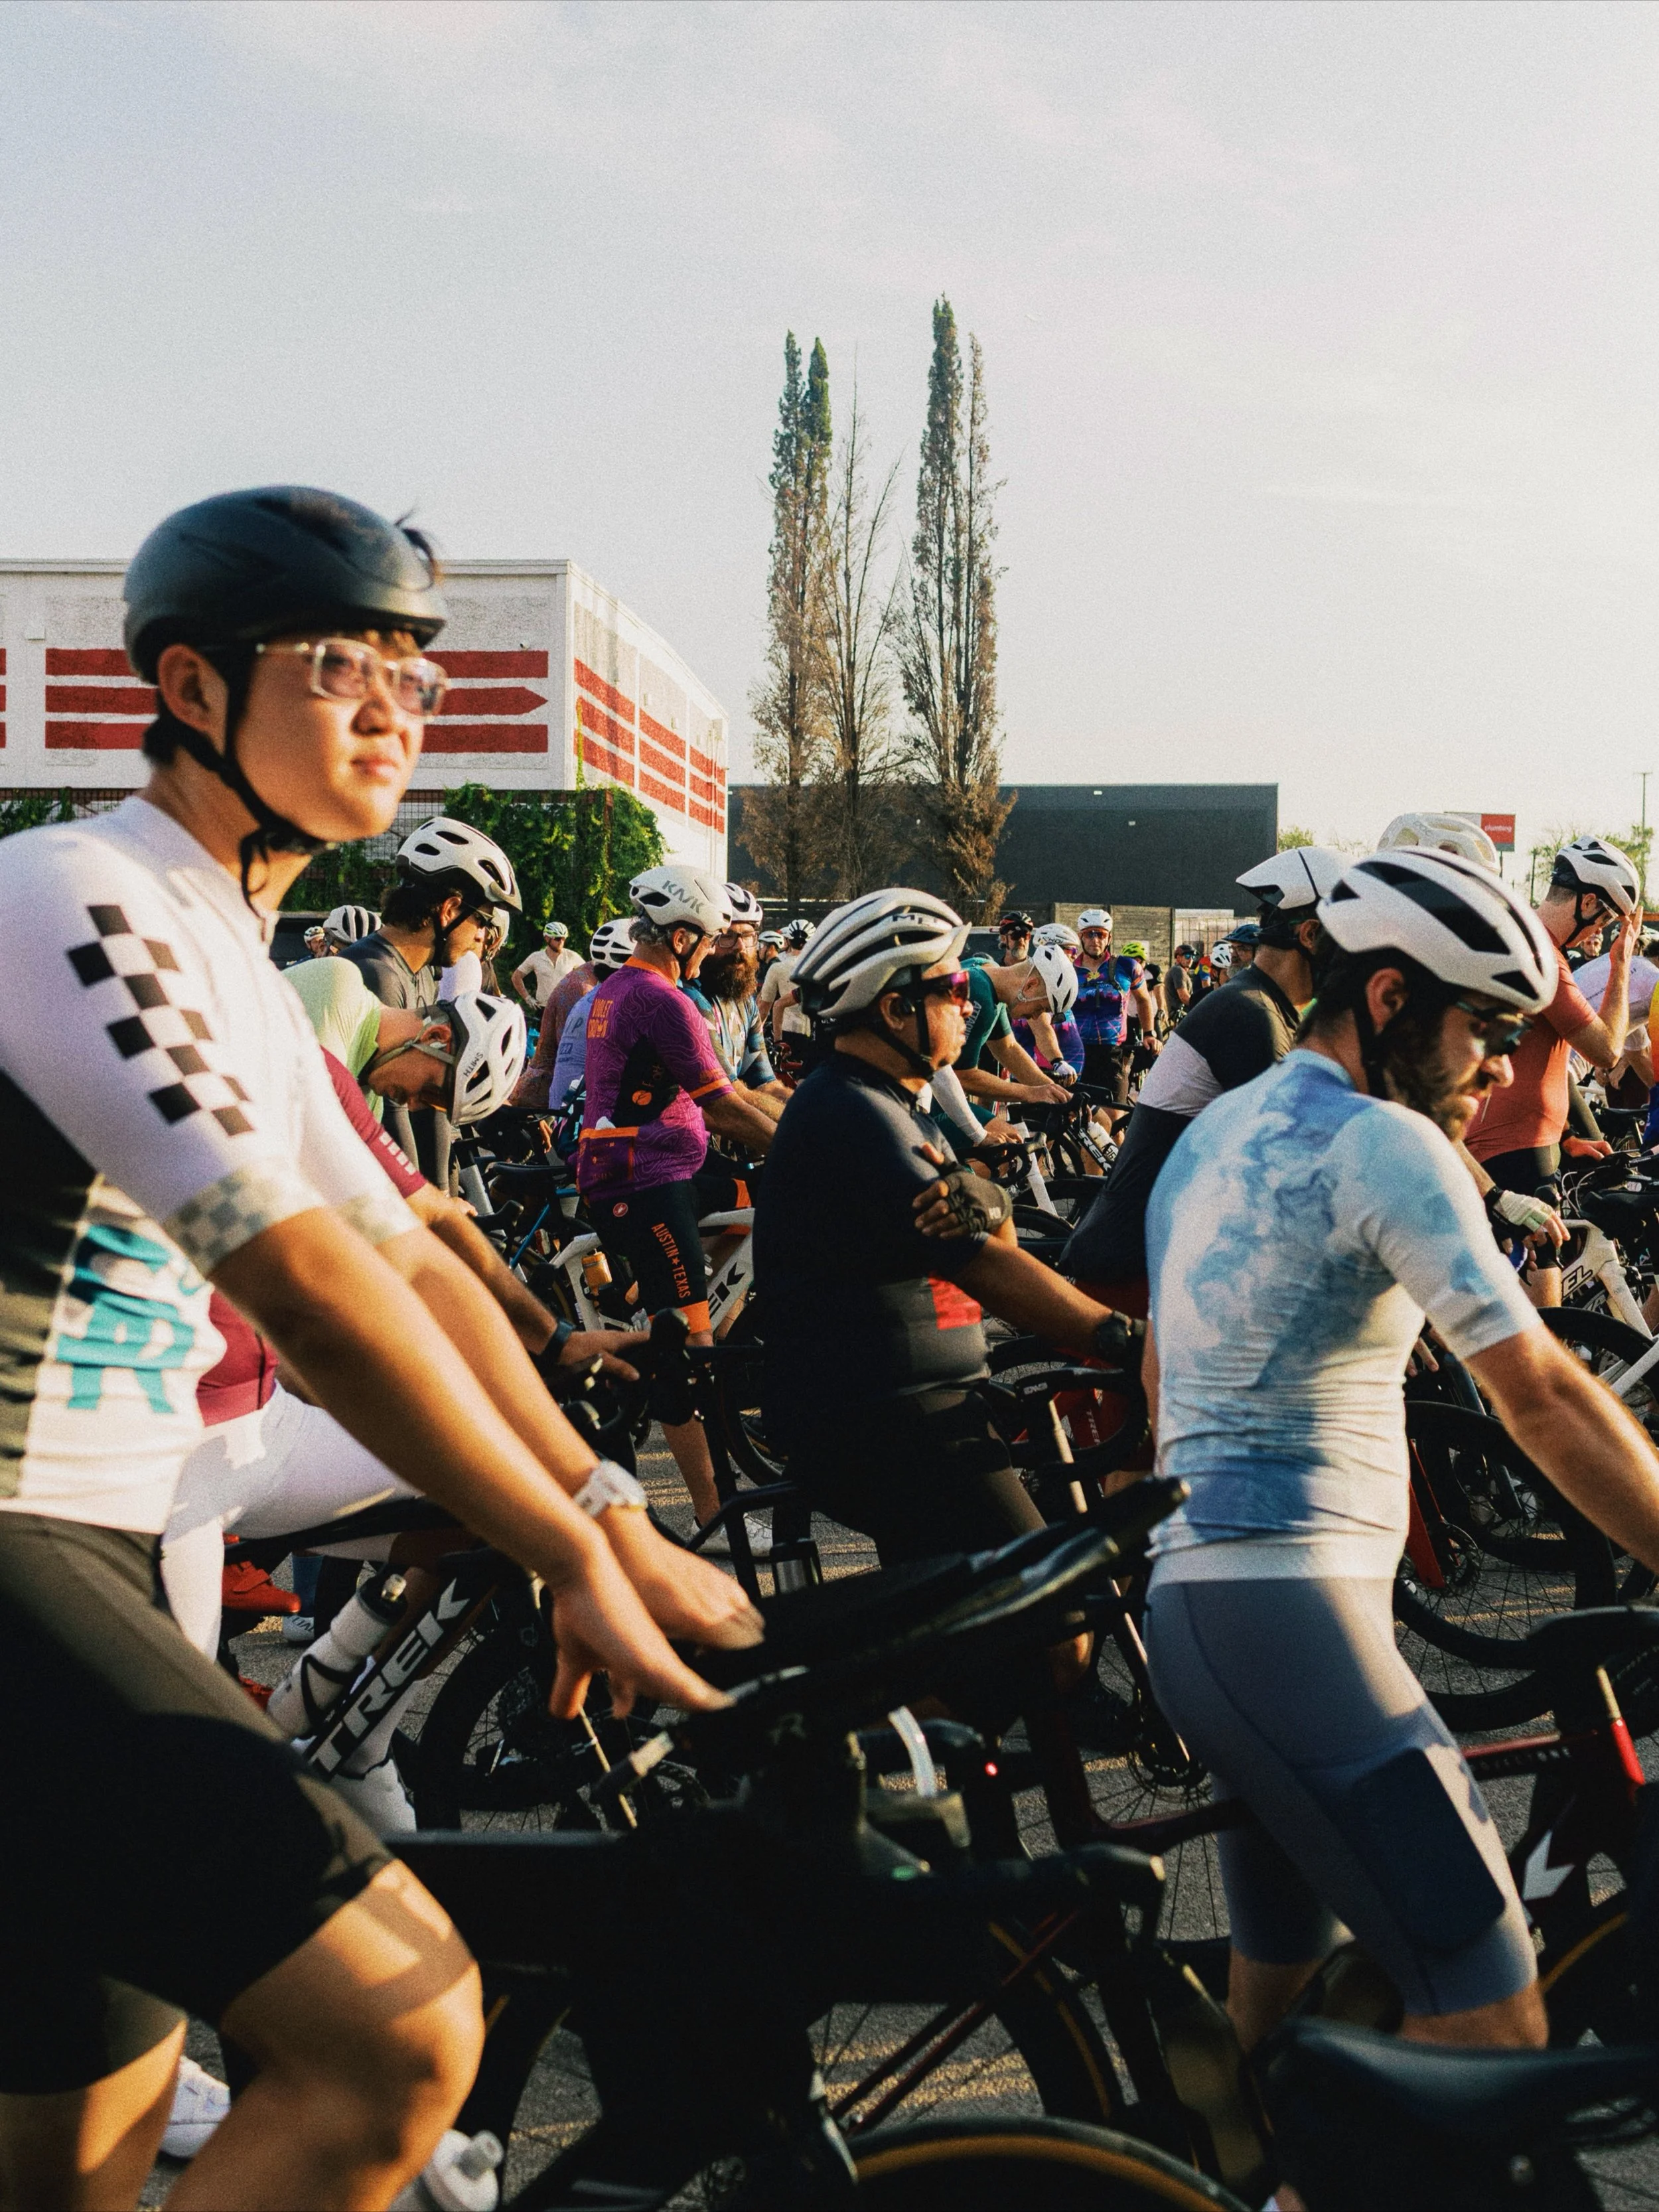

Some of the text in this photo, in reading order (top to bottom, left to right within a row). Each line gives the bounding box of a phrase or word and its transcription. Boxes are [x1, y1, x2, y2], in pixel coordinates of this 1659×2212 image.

[662, 880, 704, 914] KASK
[463, 1052, 484, 1077] SMITH
[648, 1222, 691, 1299] AUSTIN TEXAS
[307, 1578, 470, 1773] TREK
